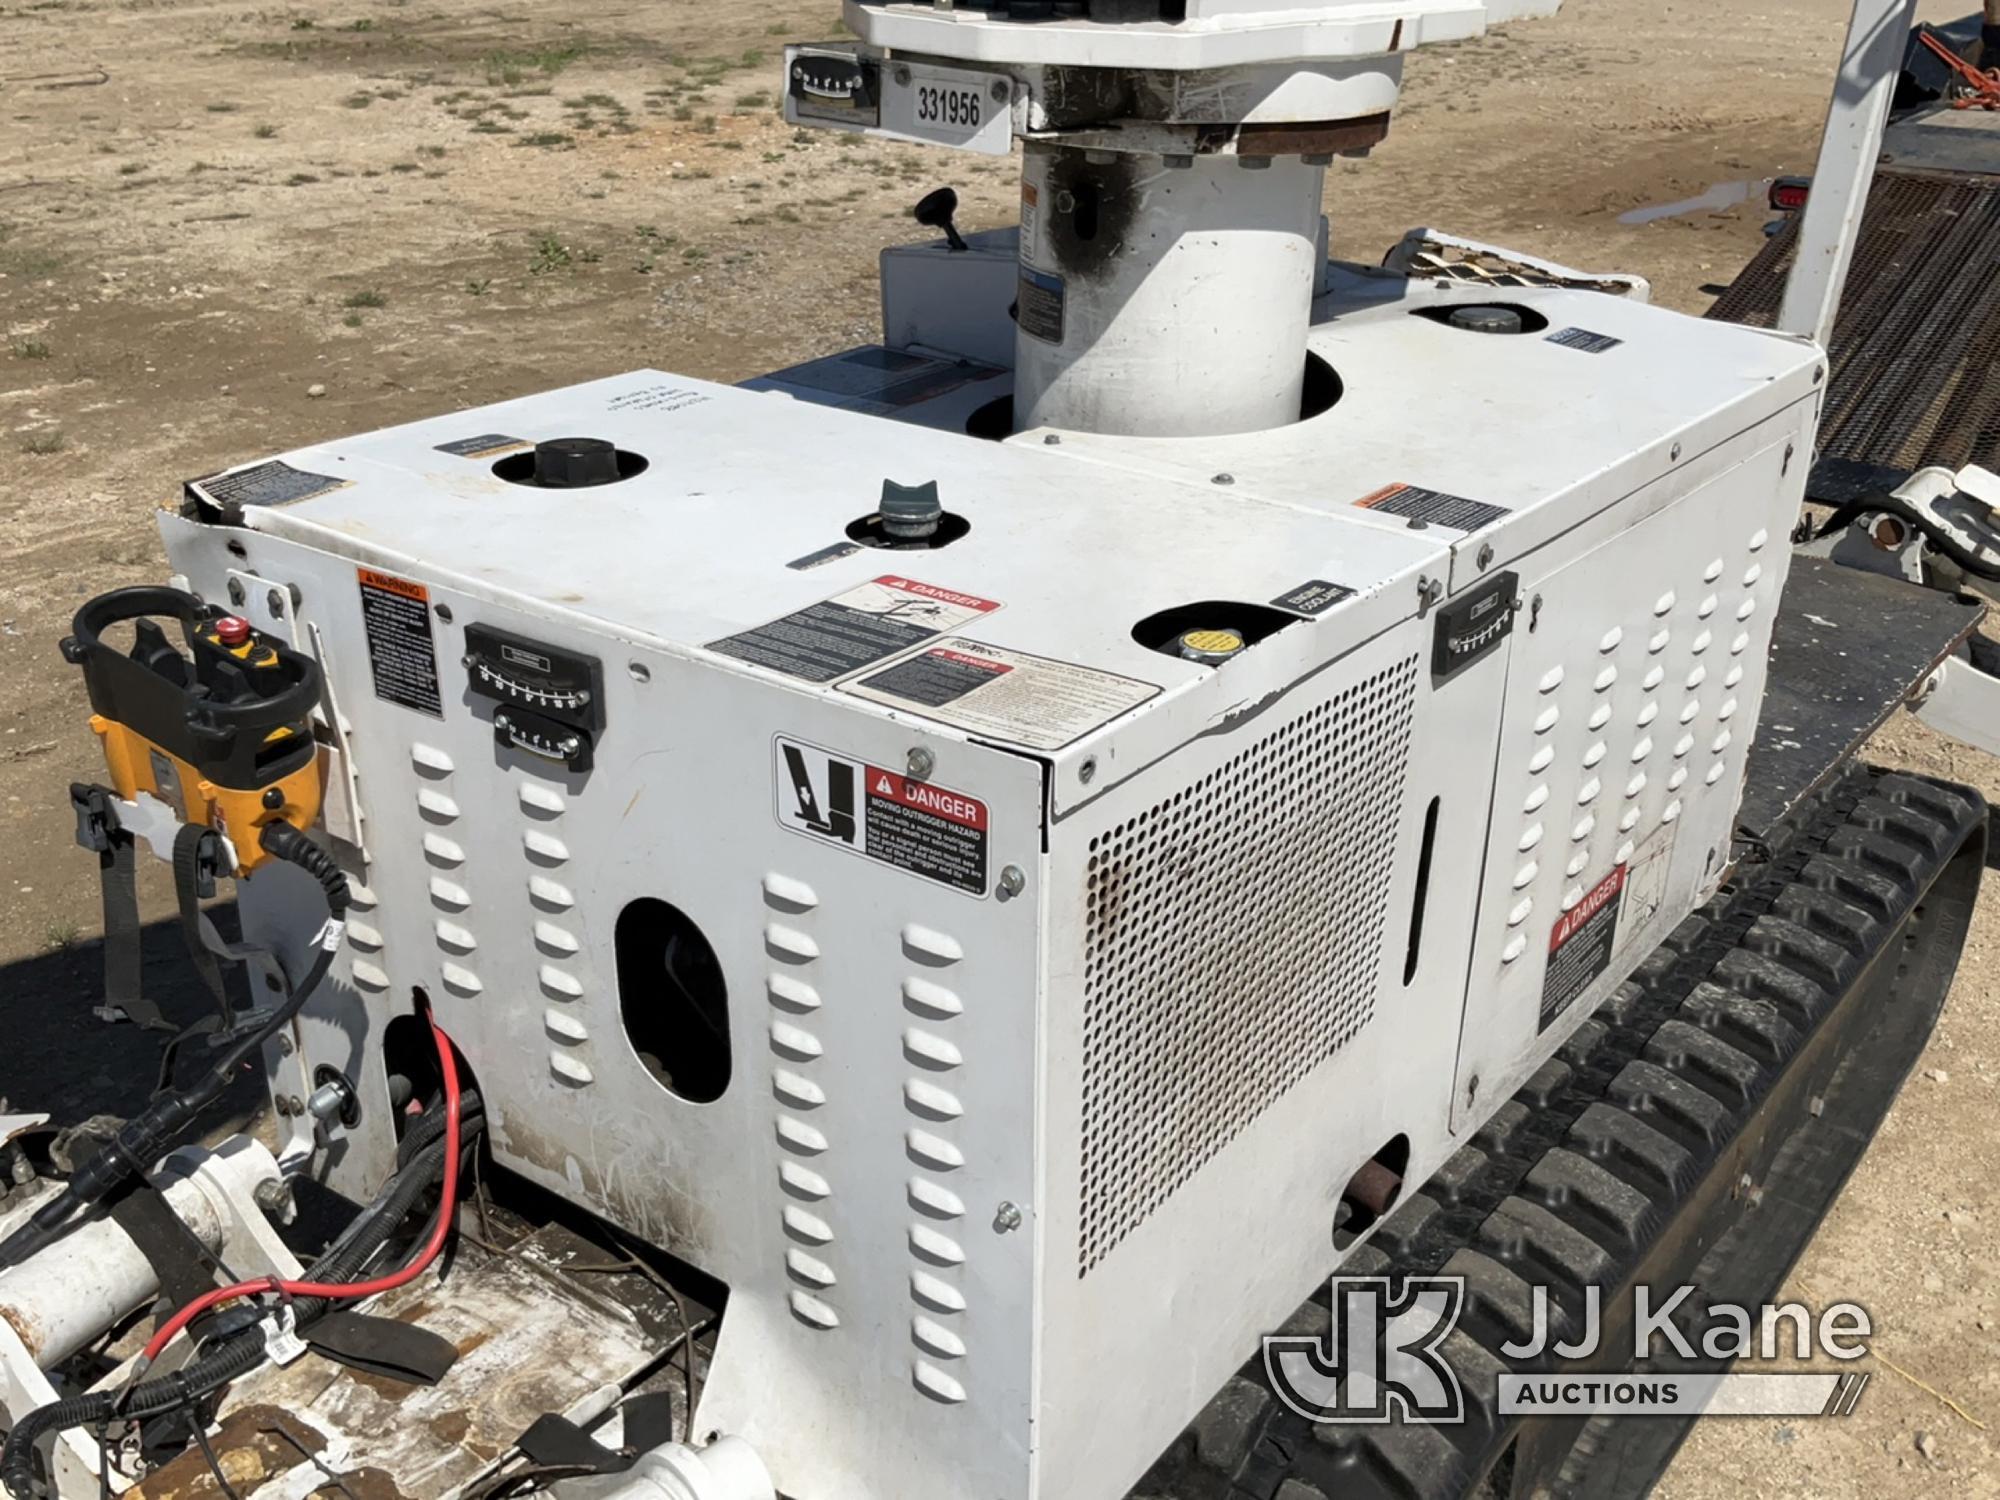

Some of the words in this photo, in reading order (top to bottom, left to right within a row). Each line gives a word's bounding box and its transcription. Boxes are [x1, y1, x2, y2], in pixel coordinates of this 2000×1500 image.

[918, 86, 980, 127] 331956
[911, 584, 981, 608] DANGER
[952, 654, 998, 669] DANGER
[871, 797, 900, 814] MOVING
[902, 807, 946, 829] OUTRIGGER
[948, 822, 980, 841] HAZARD
[906, 783, 976, 822] DANGER
[917, 824, 941, 839] moving
[1572, 874, 1618, 928] DANGER
